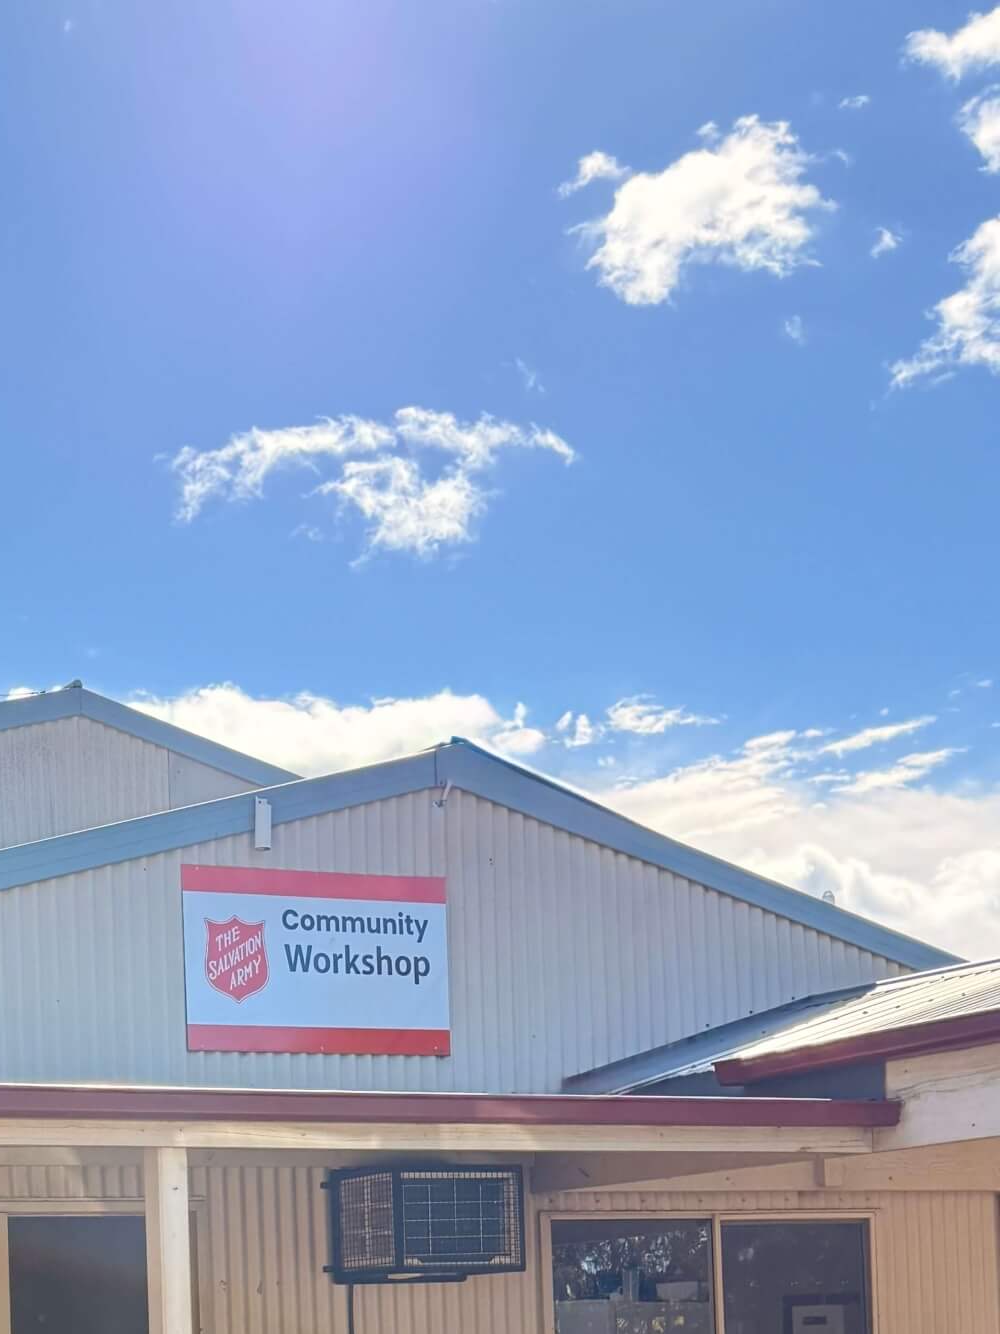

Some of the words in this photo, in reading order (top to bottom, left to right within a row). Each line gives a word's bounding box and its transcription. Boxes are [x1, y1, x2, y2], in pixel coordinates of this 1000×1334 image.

[215, 926, 241, 951] THE
[281, 909, 429, 943] Community
[208, 931, 262, 981] SALVATION
[229, 956, 261, 990] ARMY
[284, 944, 431, 985] Workshop
